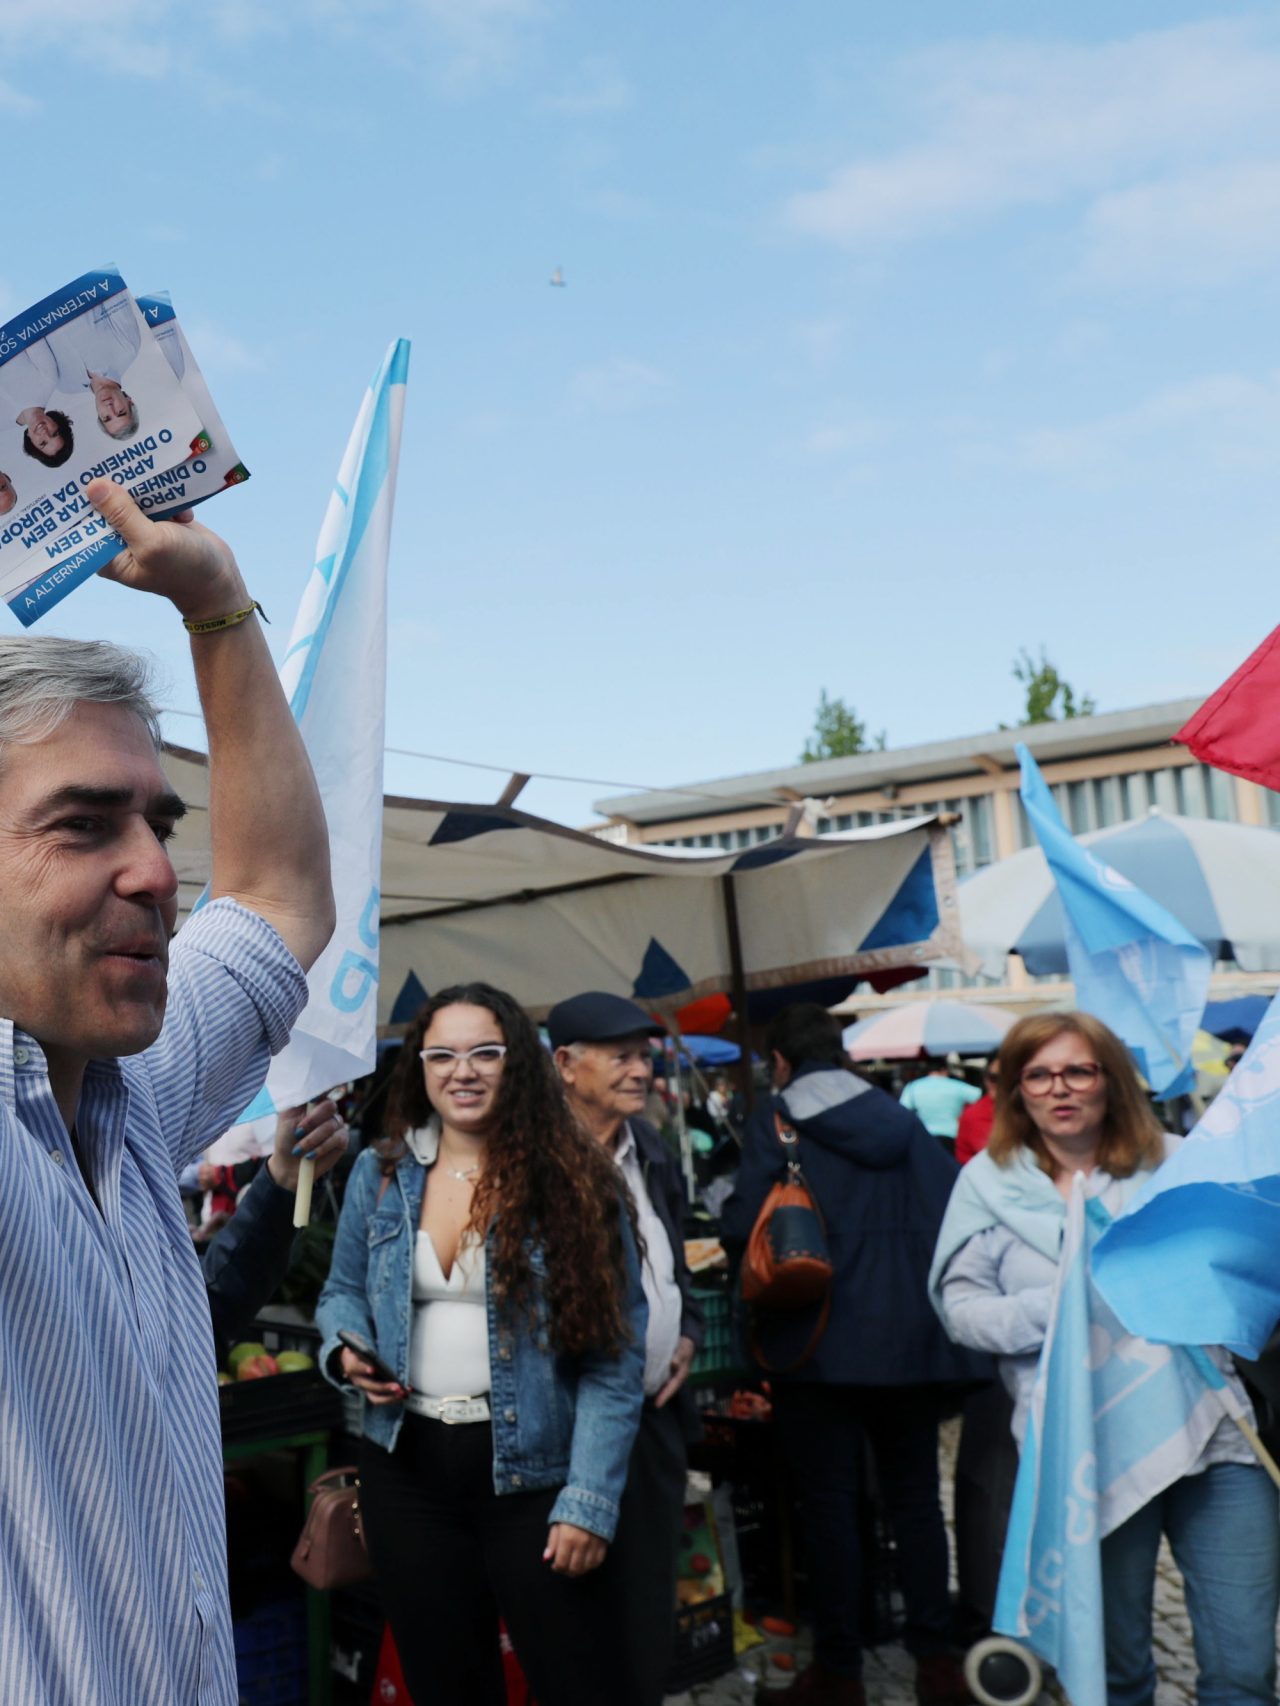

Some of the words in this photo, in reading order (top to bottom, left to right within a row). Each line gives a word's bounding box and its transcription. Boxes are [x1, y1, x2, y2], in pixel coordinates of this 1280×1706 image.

[98, 279, 109, 291] A
[17, 286, 97, 341] ALTERNATIVA
[148, 306, 159, 318] A
[159, 429, 172, 443] O
[80, 436, 158, 485] DINHEIRO
[192, 460, 207, 474] O
[53, 480, 79, 503] DA
[21, 517, 58, 549] BEM
[45, 520, 83, 559] BEM
[24, 597, 36, 609] A
[35, 537, 108, 600] ALTERNATIVA
